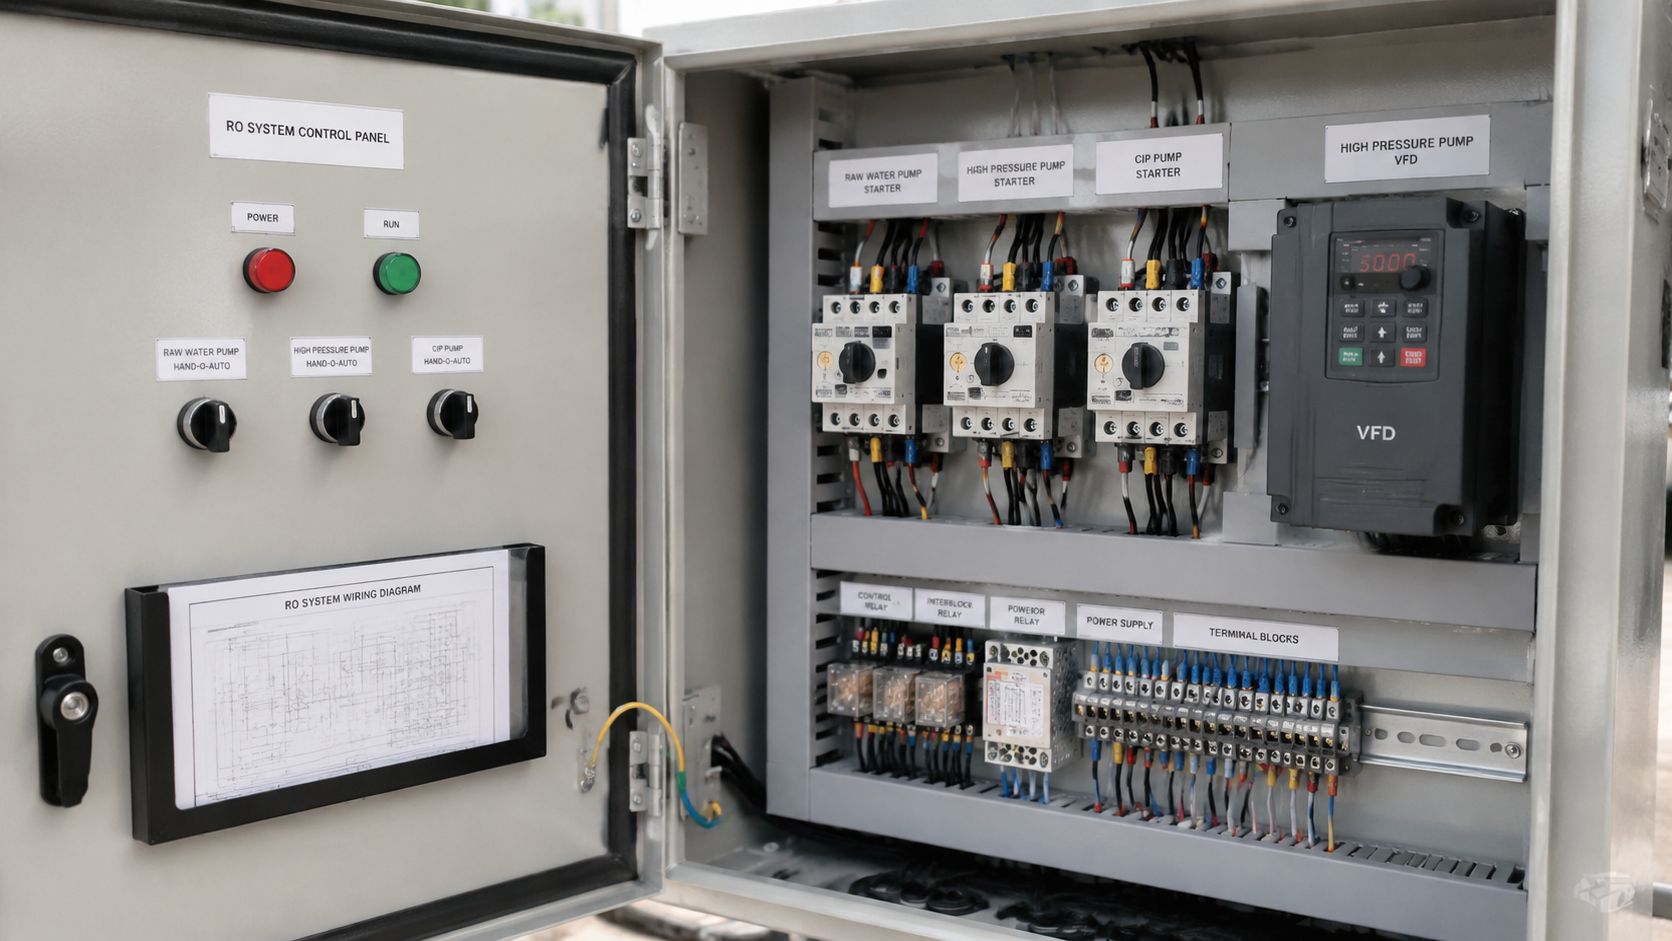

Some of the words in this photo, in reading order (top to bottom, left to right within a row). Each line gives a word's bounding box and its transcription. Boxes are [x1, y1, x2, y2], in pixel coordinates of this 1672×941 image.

[227, 120, 243, 132] RO
[248, 122, 294, 136] SYSTEM
[299, 127, 351, 140] CONTROL
[356, 131, 389, 143] PANEL
[1341, 142, 1368, 153] HIGH
[1373, 138, 1434, 151] PRESSURE
[1439, 136, 1473, 147] PUMP
[1135, 154, 1151, 163] CIP
[1154, 152, 1182, 162] PUMP
[1395, 154, 1417, 165] VFD
[967, 165, 988, 174] HIGH
[991, 162, 1037, 173] PRESSURE
[1041, 161, 1065, 170] PUMP
[1136, 167, 1180, 178] STARTER
[866, 171, 895, 180] WATER
[898, 169, 922, 178] PUMP
[995, 177, 1035, 187] STARTER
[864, 184, 901, 193] STARTER
[248, 213, 278, 222] POWER
[384, 220, 399, 228] RUN
[185, 348, 214, 356] WATER
[312, 346, 348, 354] PRESSURE
[174, 362, 230, 370] HAND-O-AUTO
[1357, 426, 1396, 441] VFD
[285, 600, 299, 610] RO
[302, 595, 340, 607] SYSTEM
[343, 590, 377, 601] WIRING
[380, 585, 420, 597] DIAGRAM
[938, 609, 961, 617] RELAY
[1014, 616, 1039, 625] RELAY
[1087, 617, 1117, 626] POWER
[1121, 619, 1153, 629] SUPPLY
[1260, 633, 1298, 644] BLOCKS
